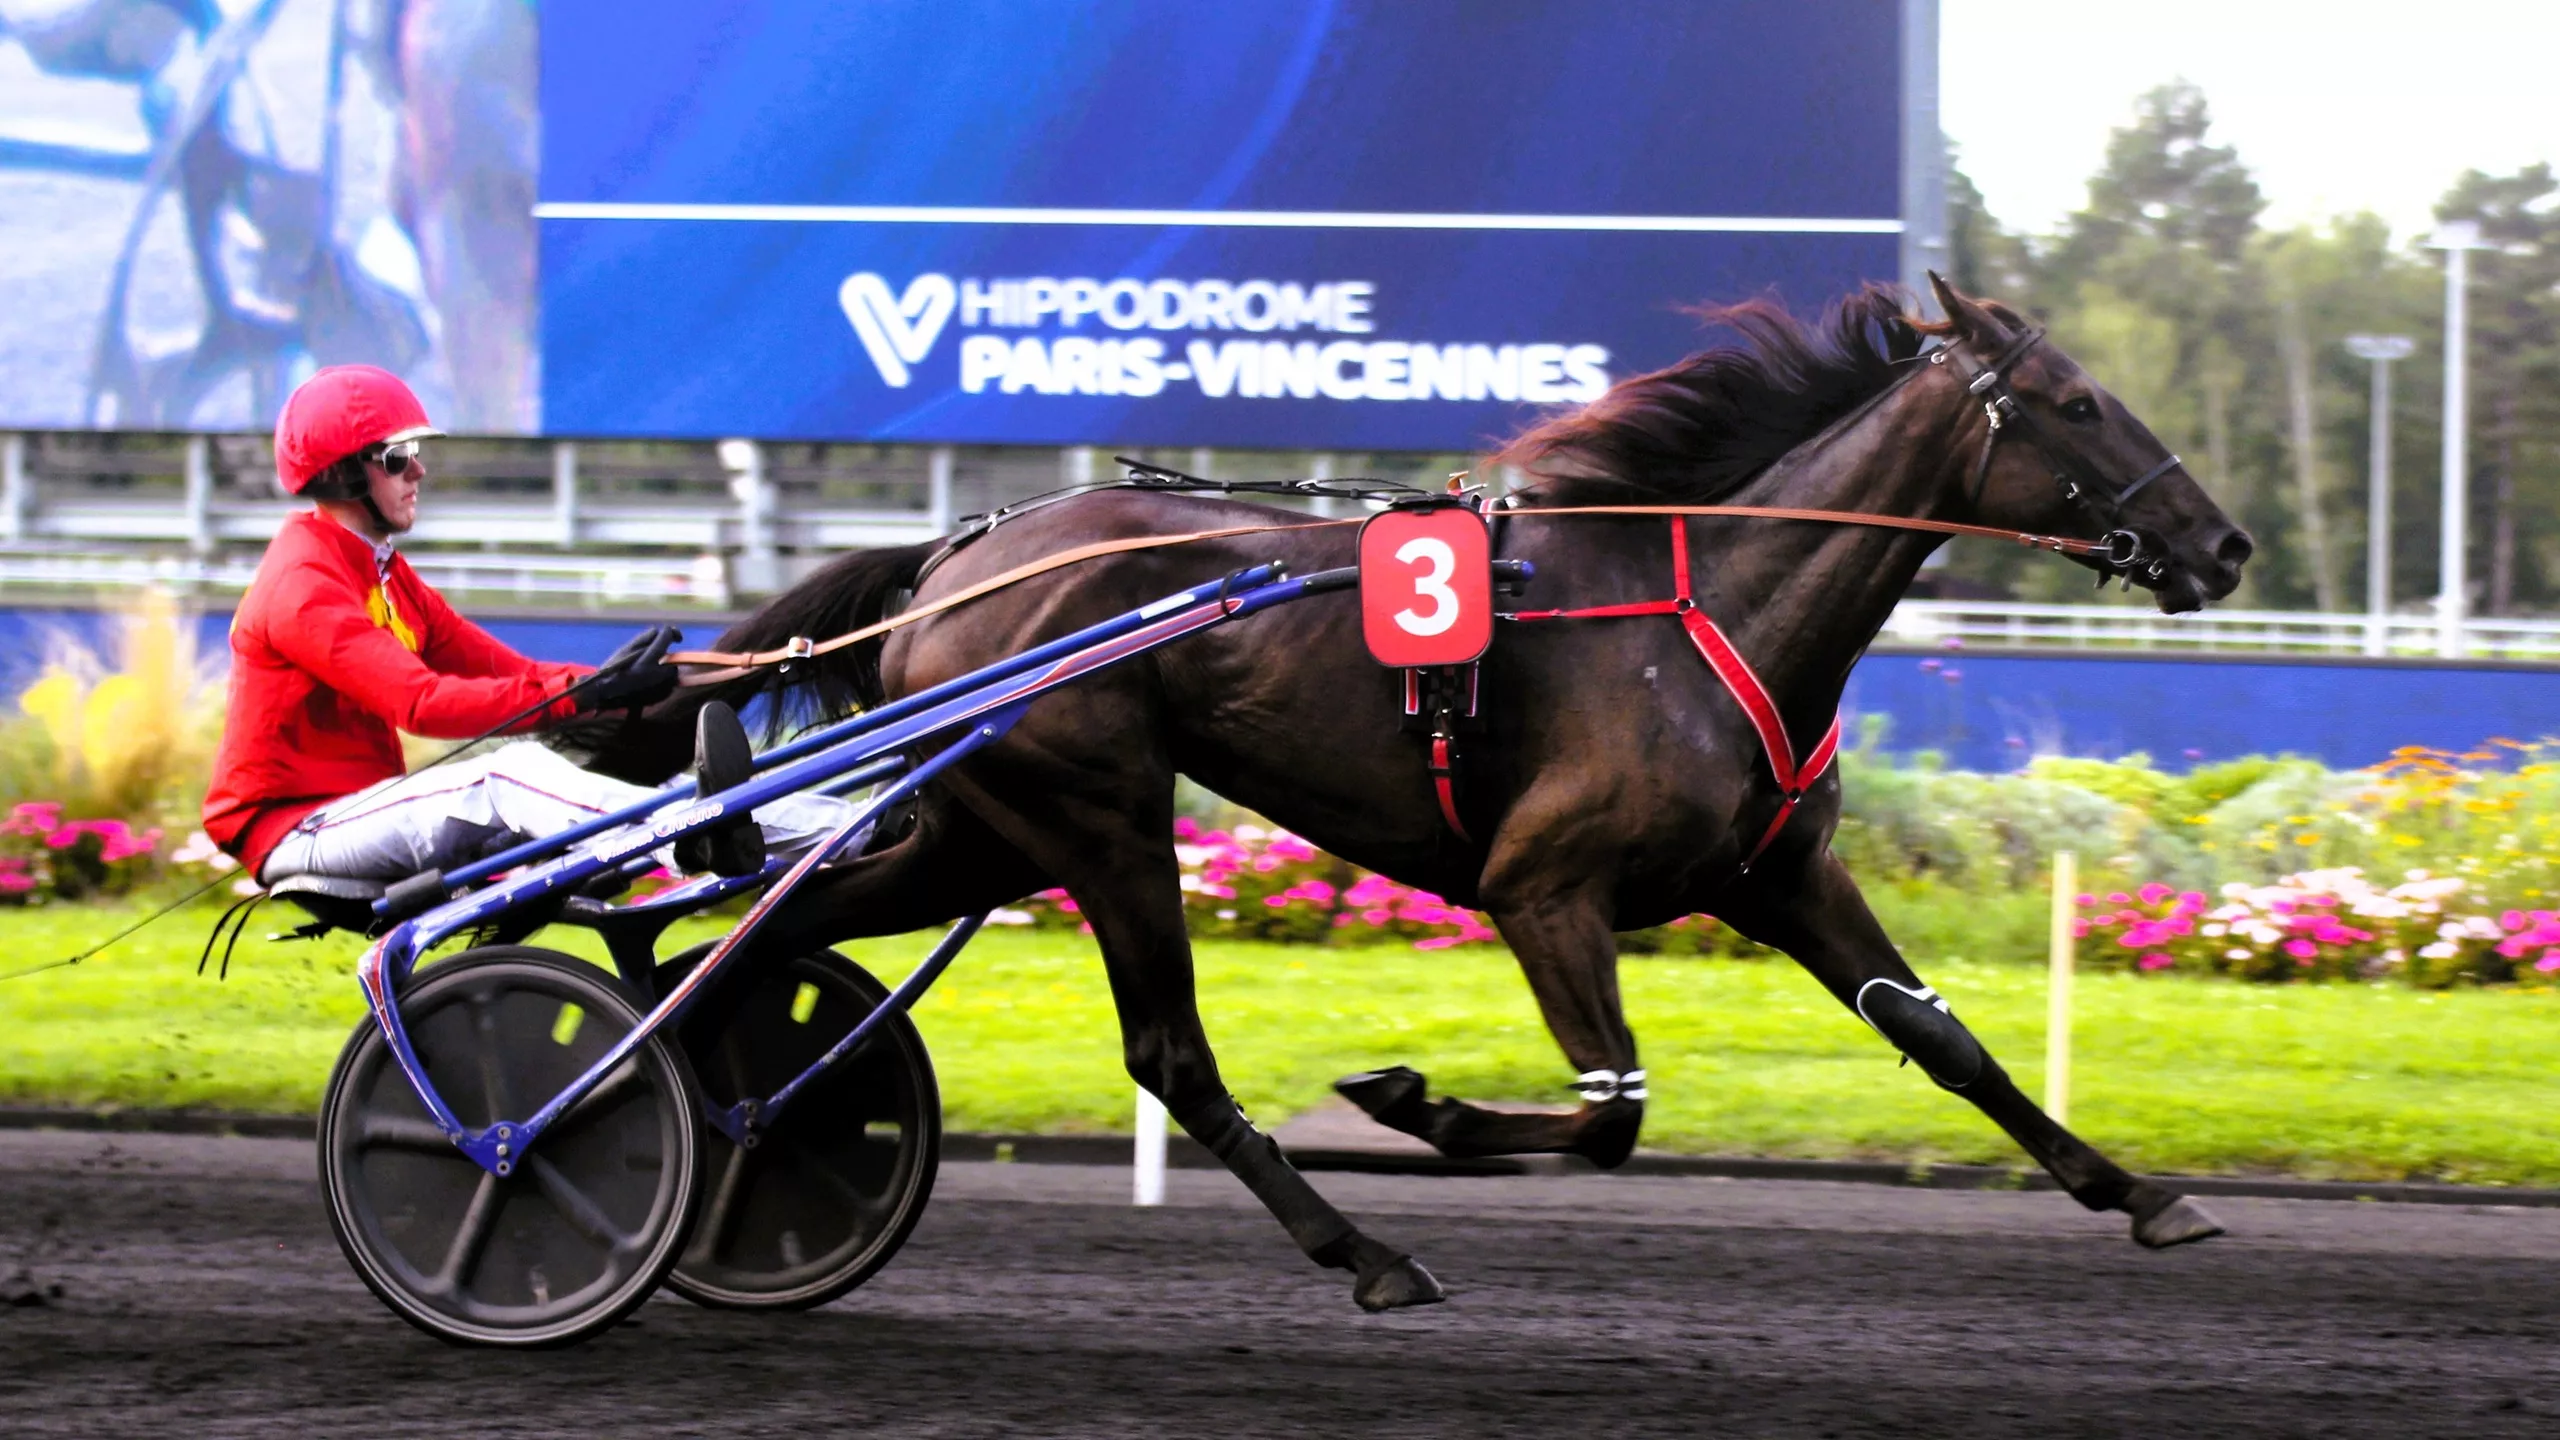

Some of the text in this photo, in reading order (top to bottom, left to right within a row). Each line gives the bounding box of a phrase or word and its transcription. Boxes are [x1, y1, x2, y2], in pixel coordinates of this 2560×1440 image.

[960, 277, 1374, 333] HIPPODROME
[960, 335, 1611, 403] PARIS-VINCENNES
[1393, 536, 1459, 636] 3
